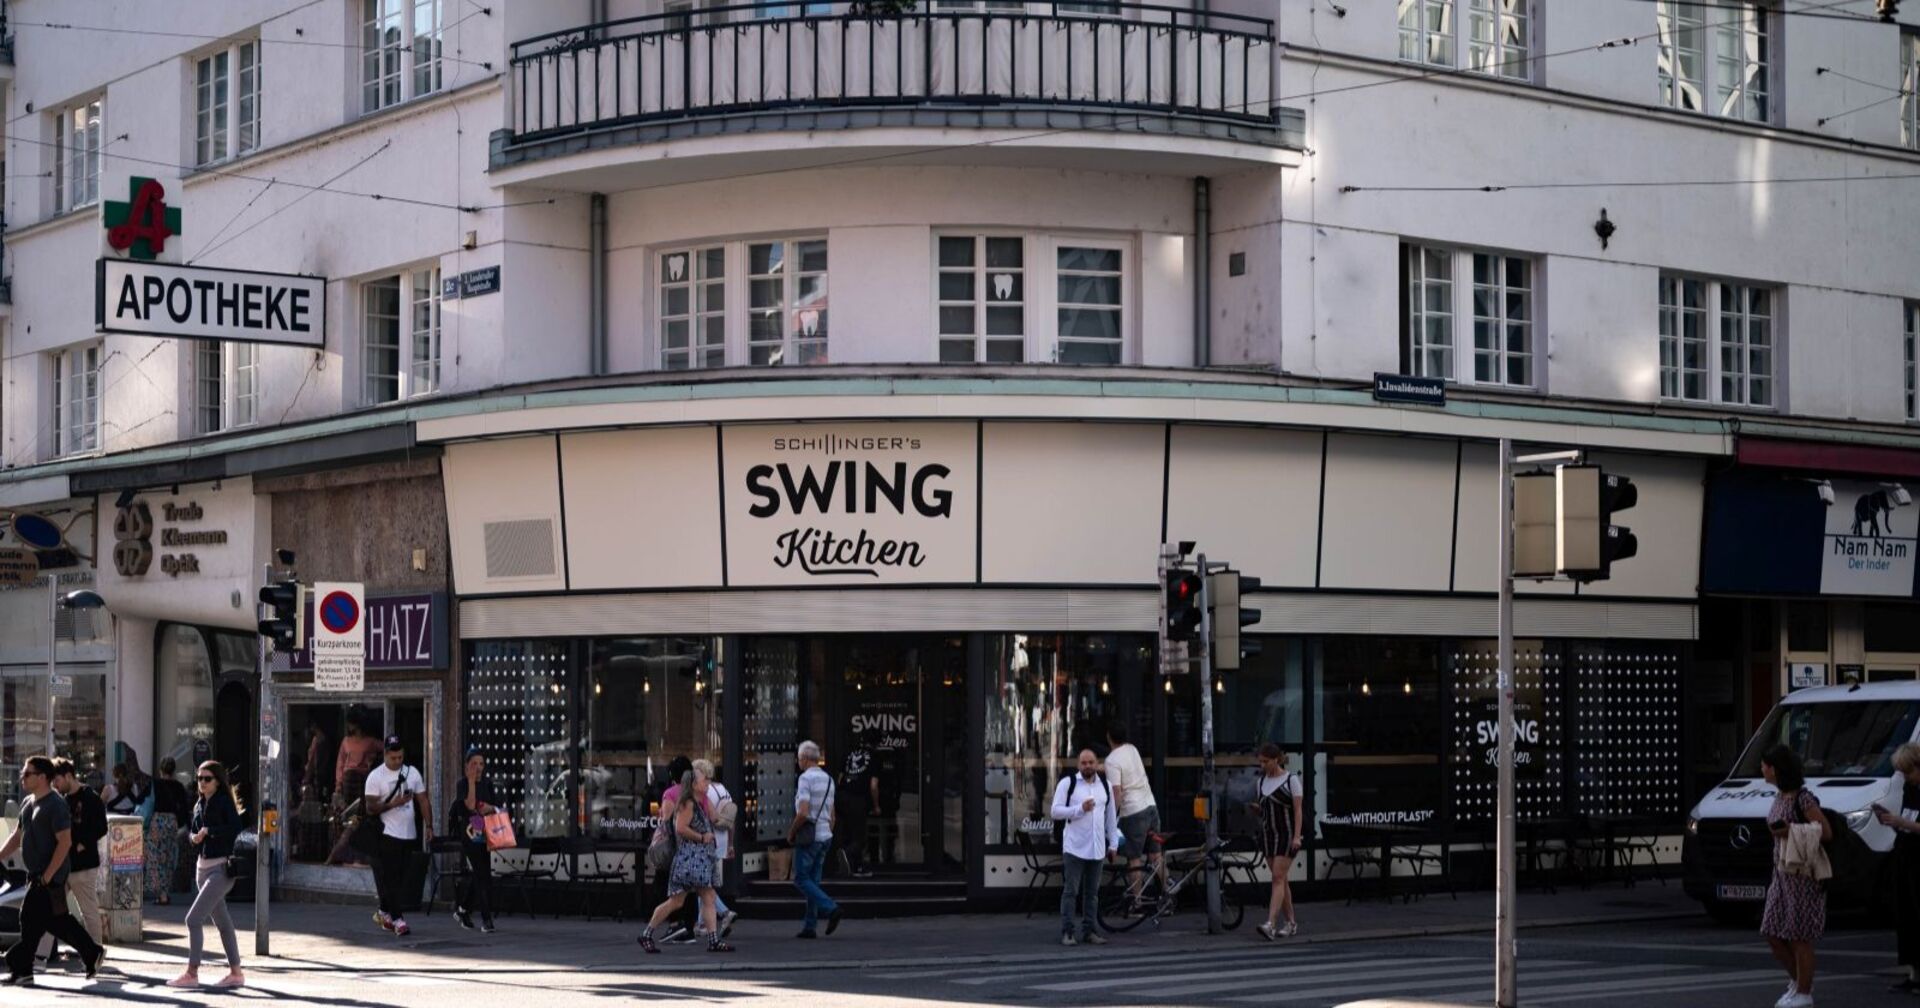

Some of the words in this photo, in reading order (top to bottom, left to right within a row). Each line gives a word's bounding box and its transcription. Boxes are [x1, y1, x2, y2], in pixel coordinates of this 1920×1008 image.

[116, 273, 310, 333] APOTHEKE
[746, 460, 953, 519] SWING
[162, 501, 203, 522] Trude
[161, 528, 227, 547] Kleemann
[1834, 536, 1868, 555] Nam
[1873, 537, 1907, 558] Nam
[0, 551, 23, 560] ude
[773, 527, 926, 577] Kitchen
[161, 553, 199, 578] Optik
[1848, 558, 1864, 569] Der
[1866, 558, 1890, 570] Inder
[364, 603, 430, 661] HATZ
[317, 639, 362, 650] Kurzparkzone
[851, 714, 917, 733] SWING
[1476, 719, 1539, 744] SWNG
[1716, 789, 1777, 800] bofro
[1352, 811, 1396, 824] WITHOUT
